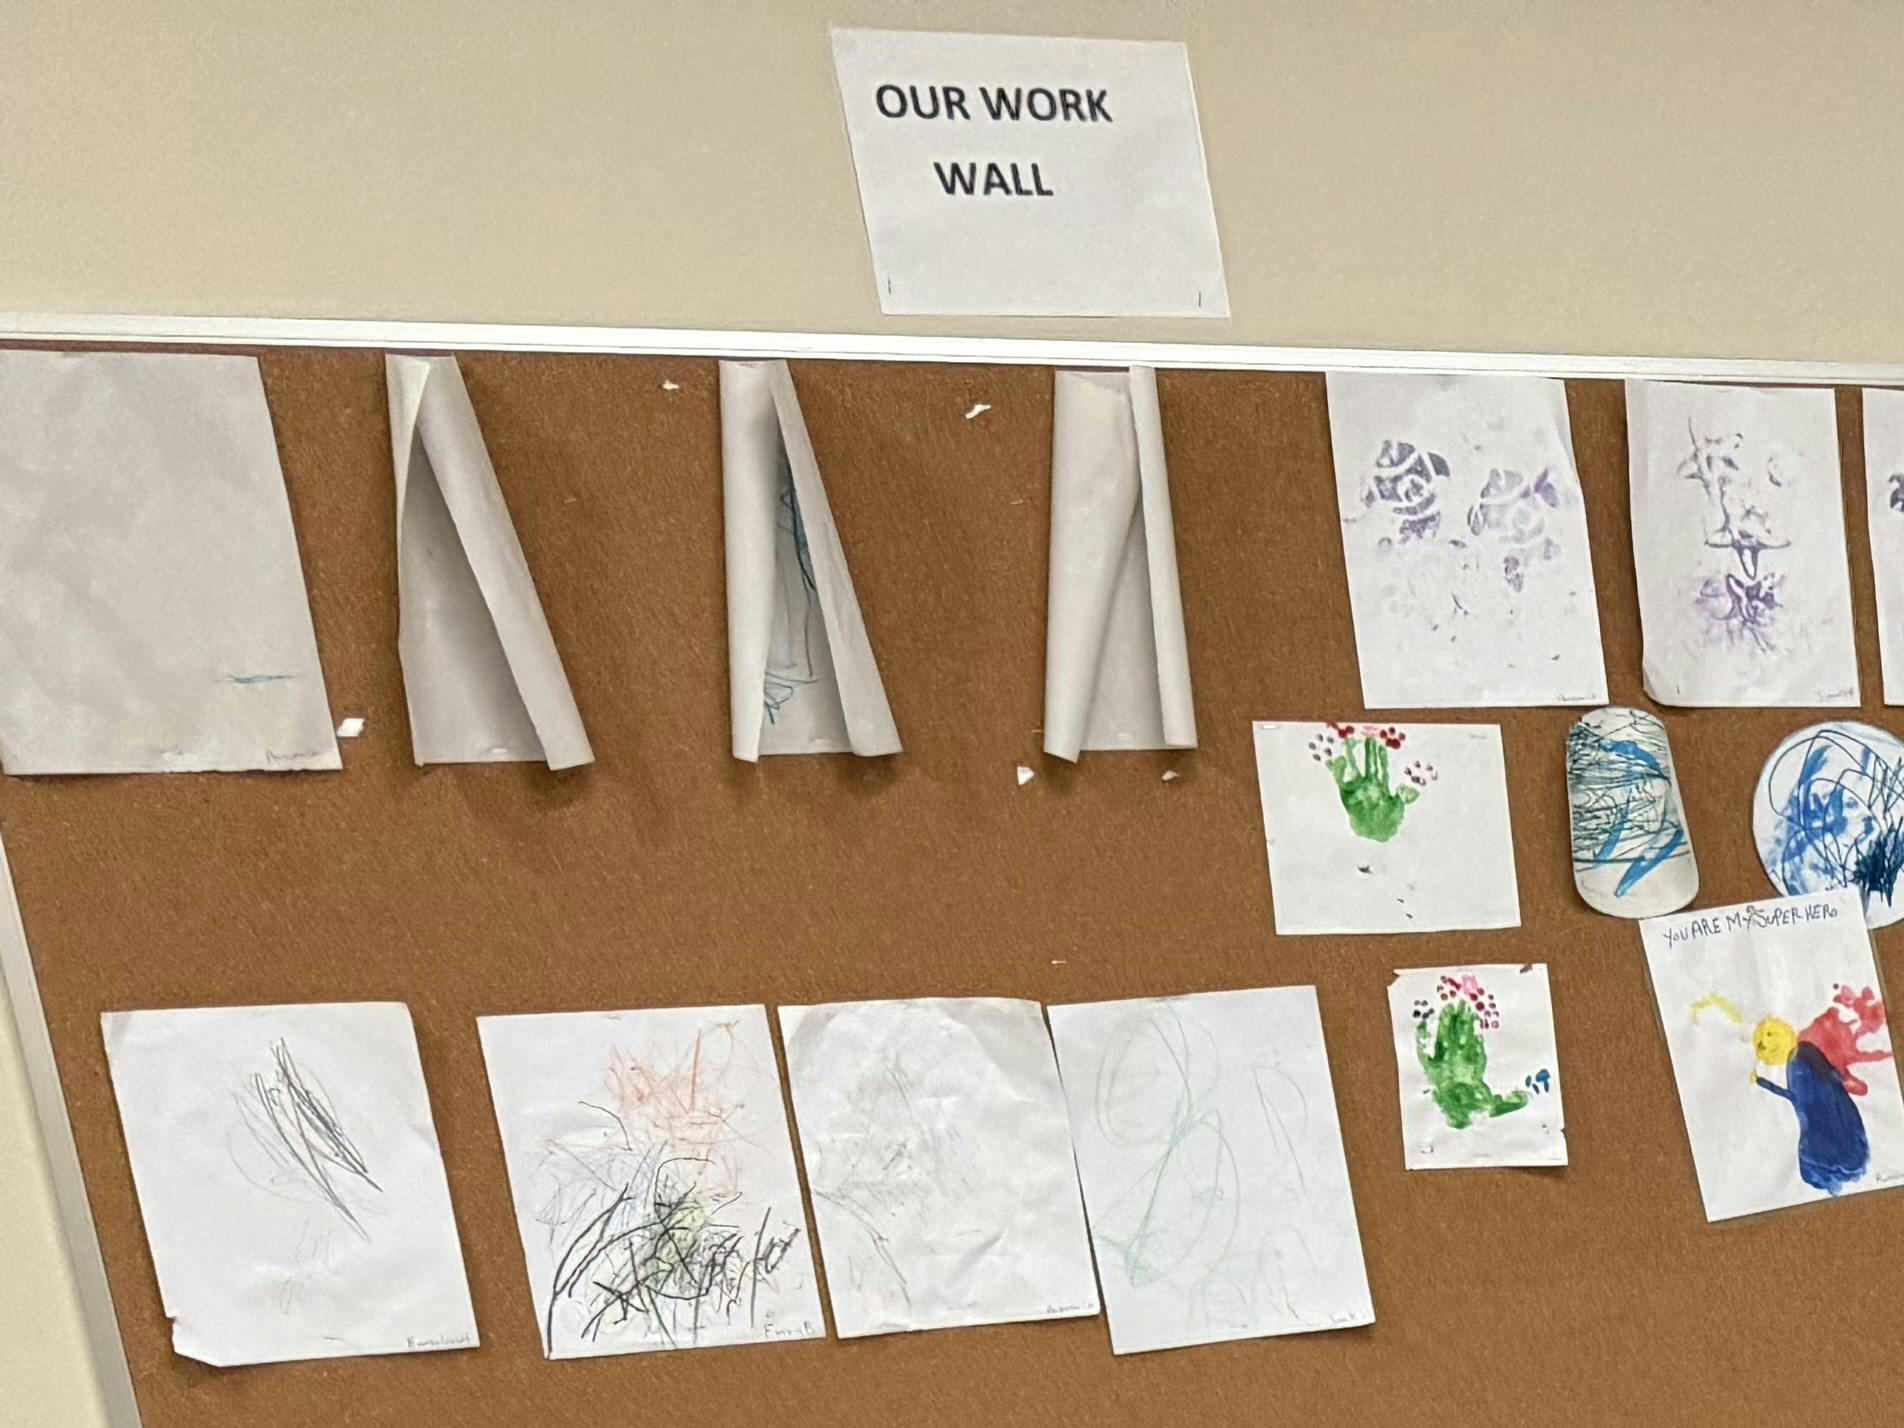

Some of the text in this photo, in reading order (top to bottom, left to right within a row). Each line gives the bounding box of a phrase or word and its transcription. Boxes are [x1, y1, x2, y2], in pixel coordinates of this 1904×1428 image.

[876, 84, 1114, 123] OUR WORK
[932, 161, 1055, 197] WALL
[1663, 927, 1689, 949] YOU
[1690, 917, 1722, 939] ARE
[1752, 906, 1803, 928] SUPER
[1805, 903, 1839, 923] HERO
